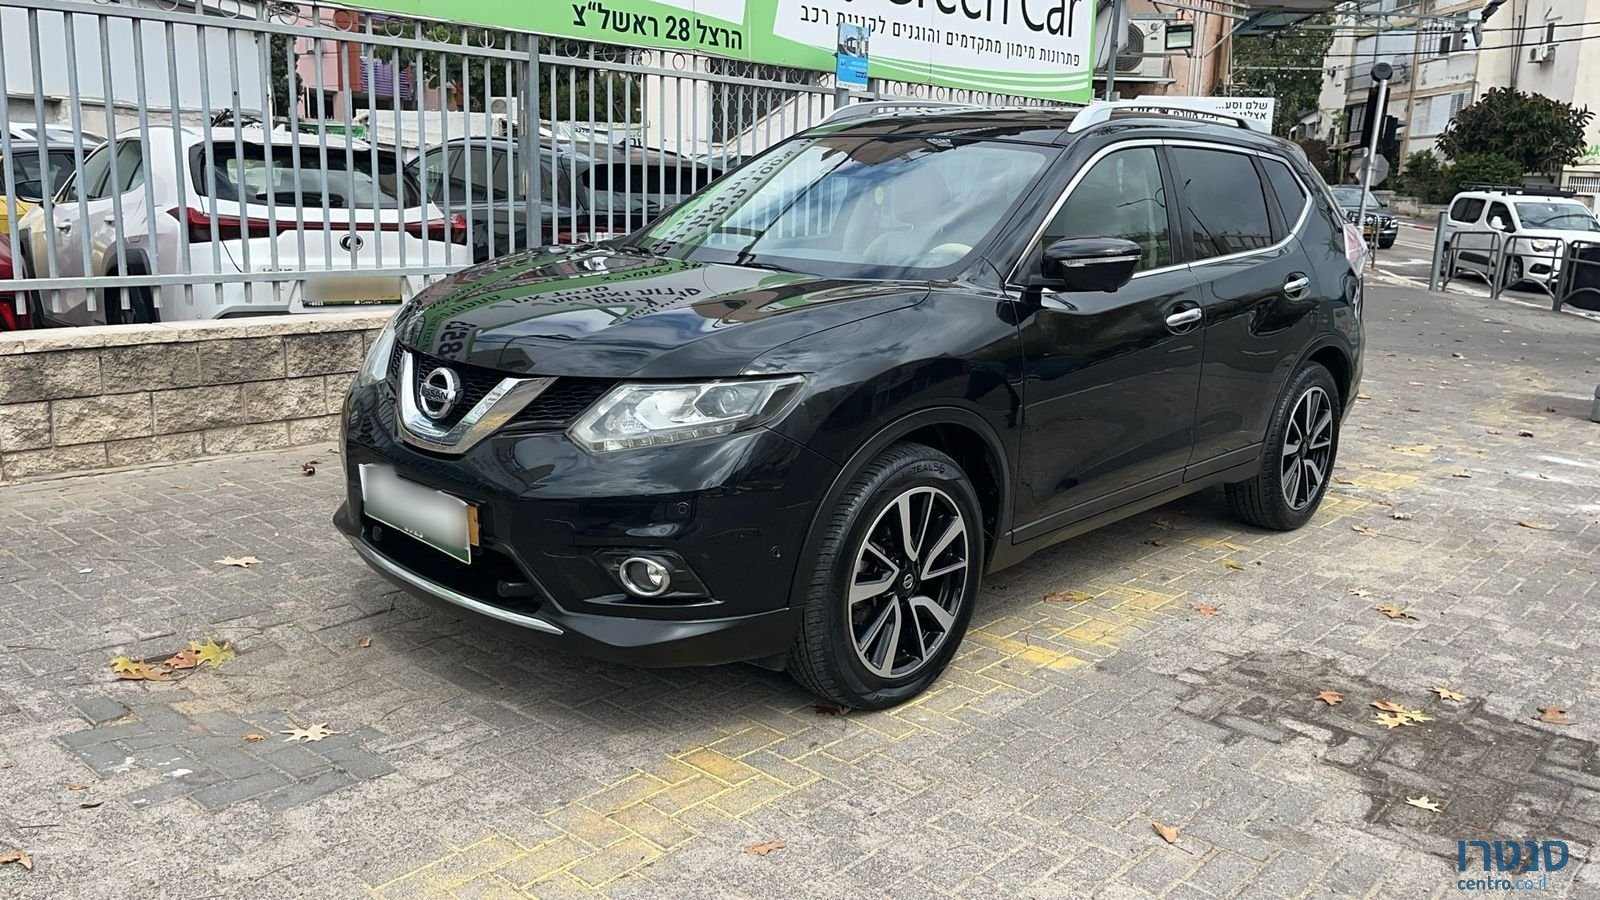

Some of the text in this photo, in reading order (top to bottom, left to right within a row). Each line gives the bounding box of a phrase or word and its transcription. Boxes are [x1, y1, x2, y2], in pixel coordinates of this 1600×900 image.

[800, 5, 829, 25] רכב
[665, 15, 690, 42] 28
[696, 19, 742, 50] הרצל
[892, 22, 940, 44] והוגנים
[946, 31, 1001, 55] מתקדמים
[1006, 42, 1035, 59] מימון
[1039, 48, 1080, 66] פתרונות
[1246, 100, 1268, 110] שלם
